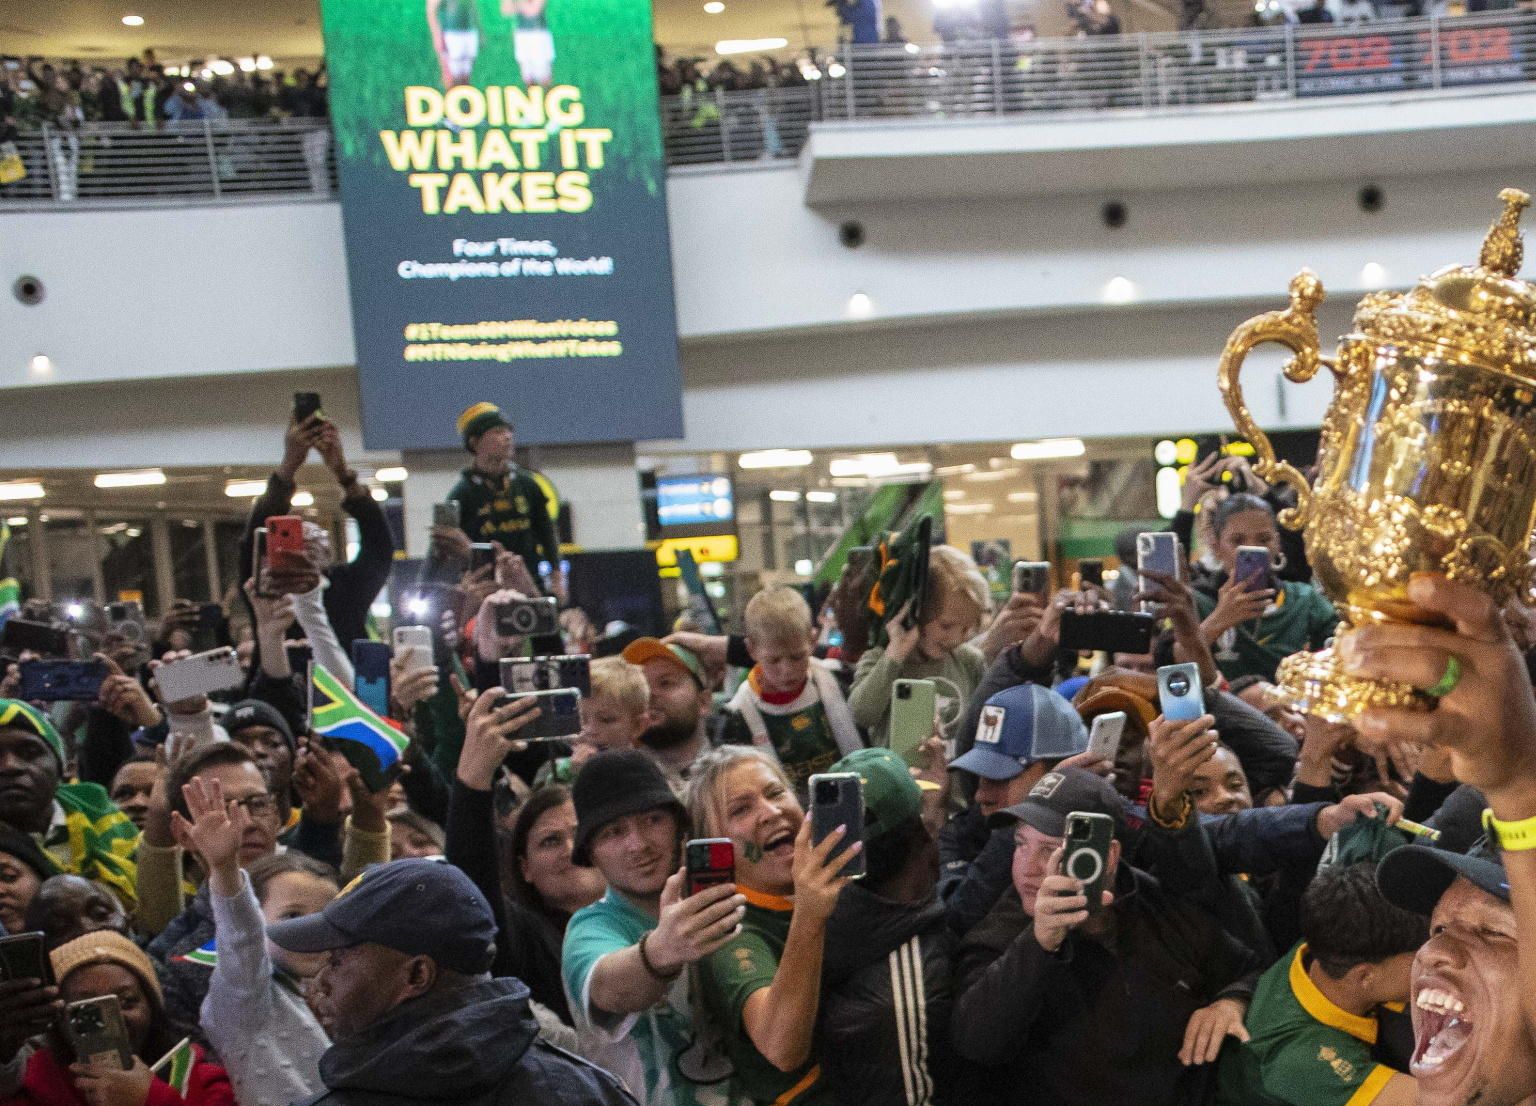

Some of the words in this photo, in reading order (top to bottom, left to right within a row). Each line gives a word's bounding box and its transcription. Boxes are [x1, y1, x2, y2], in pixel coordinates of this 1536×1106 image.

[404, 85, 585, 127] DOING
[380, 128, 549, 171] WHAT
[560, 128, 613, 170] IT
[408, 171, 594, 214] TAKES
